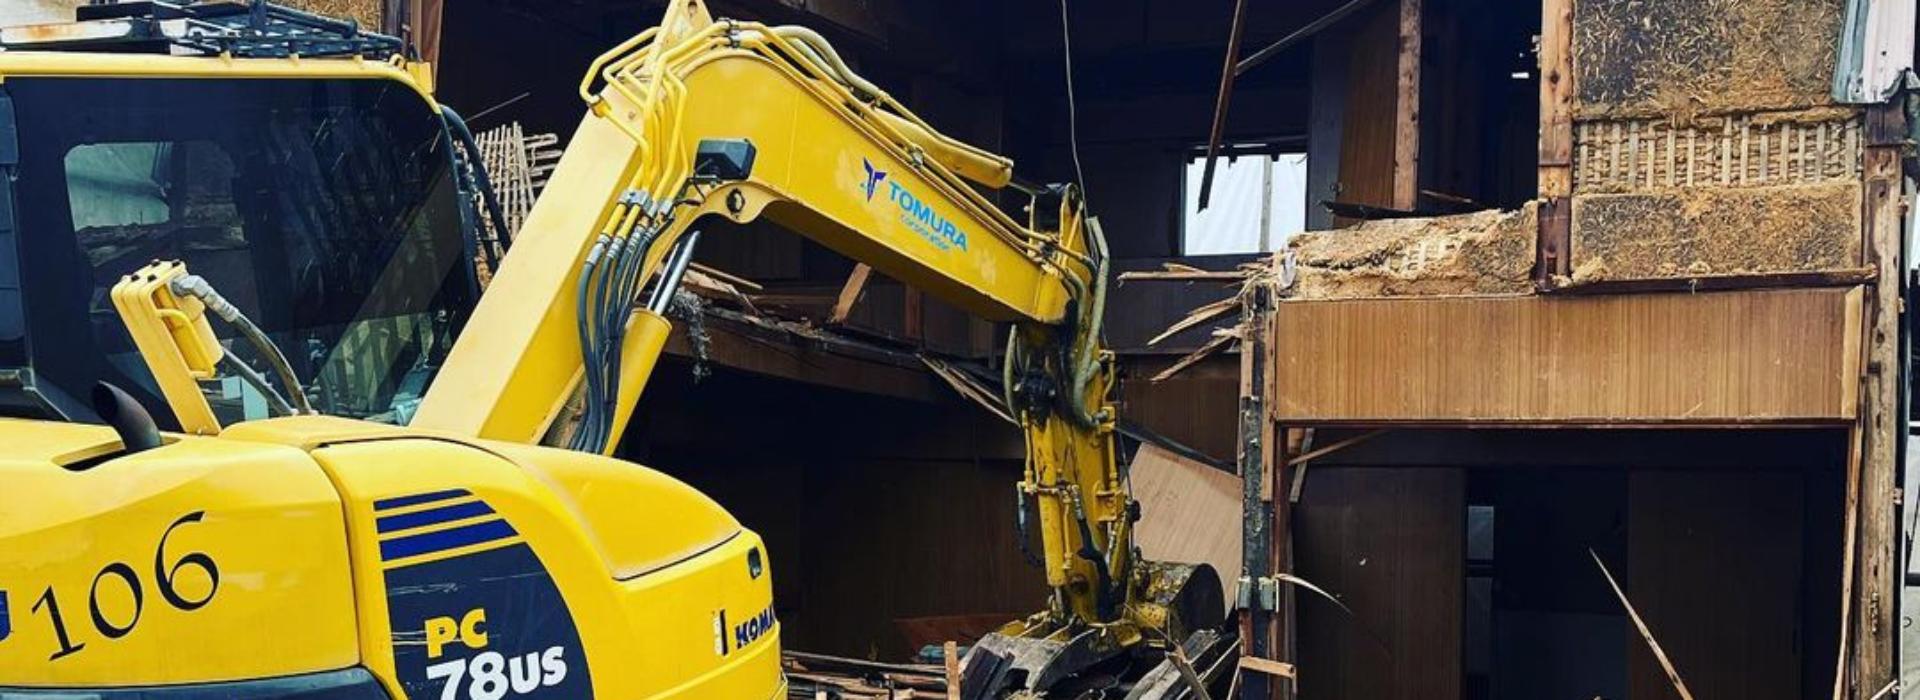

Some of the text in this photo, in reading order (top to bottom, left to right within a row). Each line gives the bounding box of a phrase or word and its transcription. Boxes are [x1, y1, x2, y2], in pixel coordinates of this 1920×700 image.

[888, 181, 968, 252] TOMURA
[32, 511, 219, 661] 106
[425, 608, 488, 658] PC
[426, 646, 567, 700] 78US
